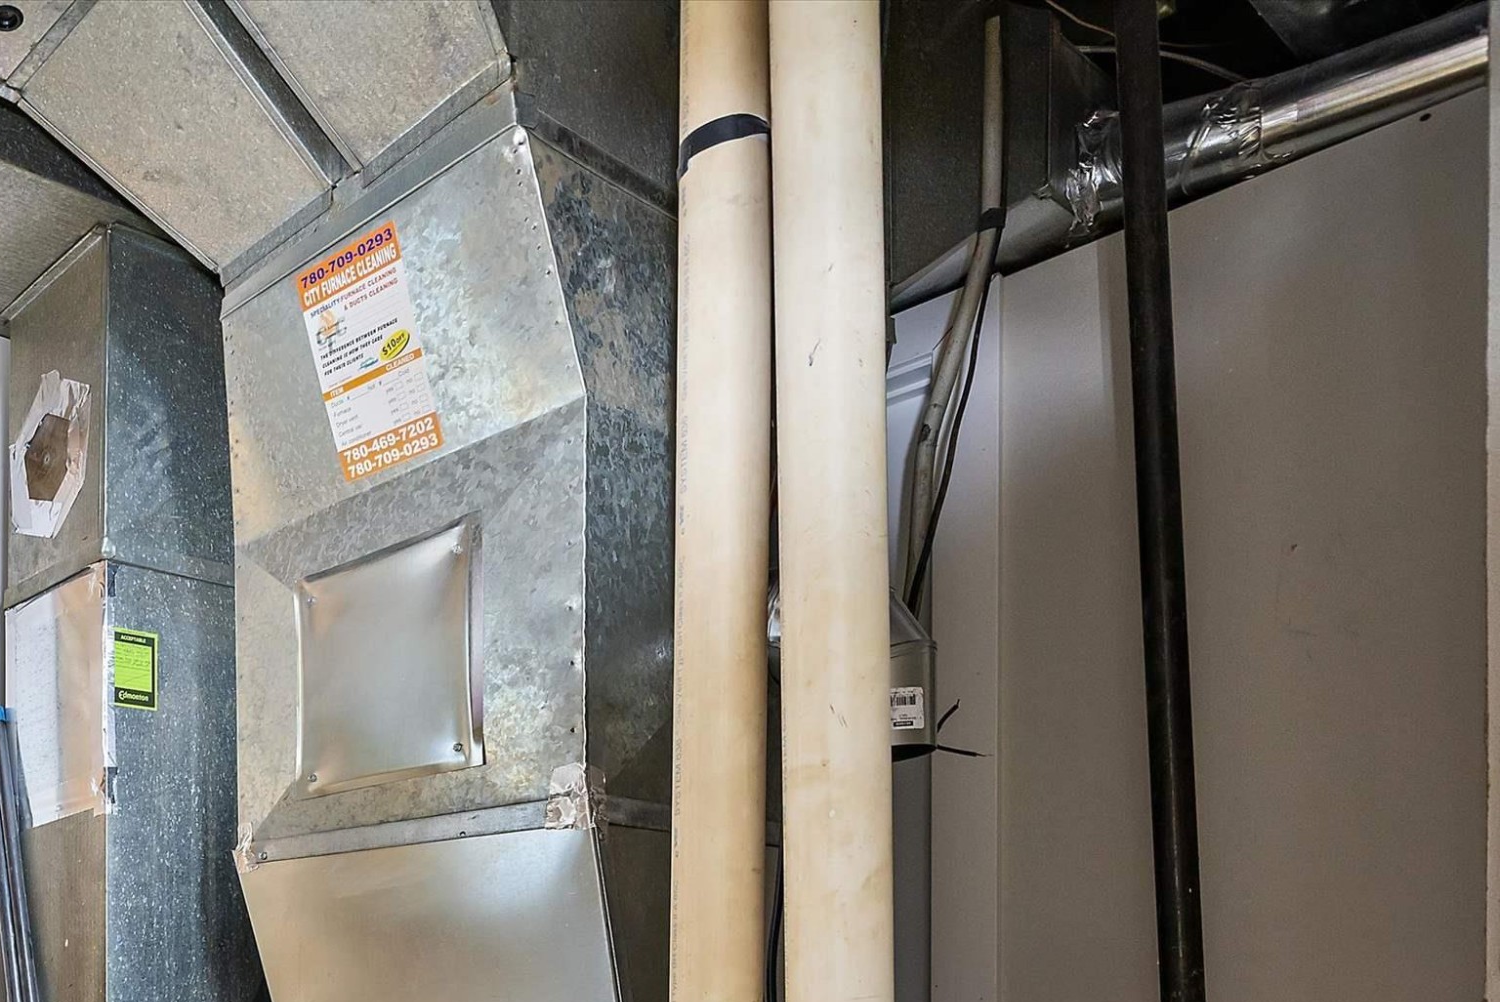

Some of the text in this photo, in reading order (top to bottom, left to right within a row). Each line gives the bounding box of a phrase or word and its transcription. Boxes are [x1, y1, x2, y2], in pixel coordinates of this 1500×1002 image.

[301, 228, 393, 288] 780-709-0293
[303, 242, 397, 307] CITY FURNACE CLEANING
[340, 283, 367, 301] FURNACE
[367, 267, 397, 287] CLEANING
[349, 294, 368, 307] DUCTS
[368, 277, 398, 297] CLEANING
[320, 317, 398, 360] THE DIFFERENCE BETWEEN FURNACE
[322, 356, 343, 369] CLEANING
[360, 340, 371, 350] THEY
[382, 338, 396, 356] $10
[330, 353, 414, 398] ITEM CLEANED
[333, 362, 346, 372] THEIR
[346, 353, 364, 366] CLIENTS
[343, 417, 435, 463] 780-469-7202
[348, 433, 438, 478] 780-709-0293
[120, 634, 147, 644] ACCEPTABLE
[118, 690, 150, 702] Edmonton
